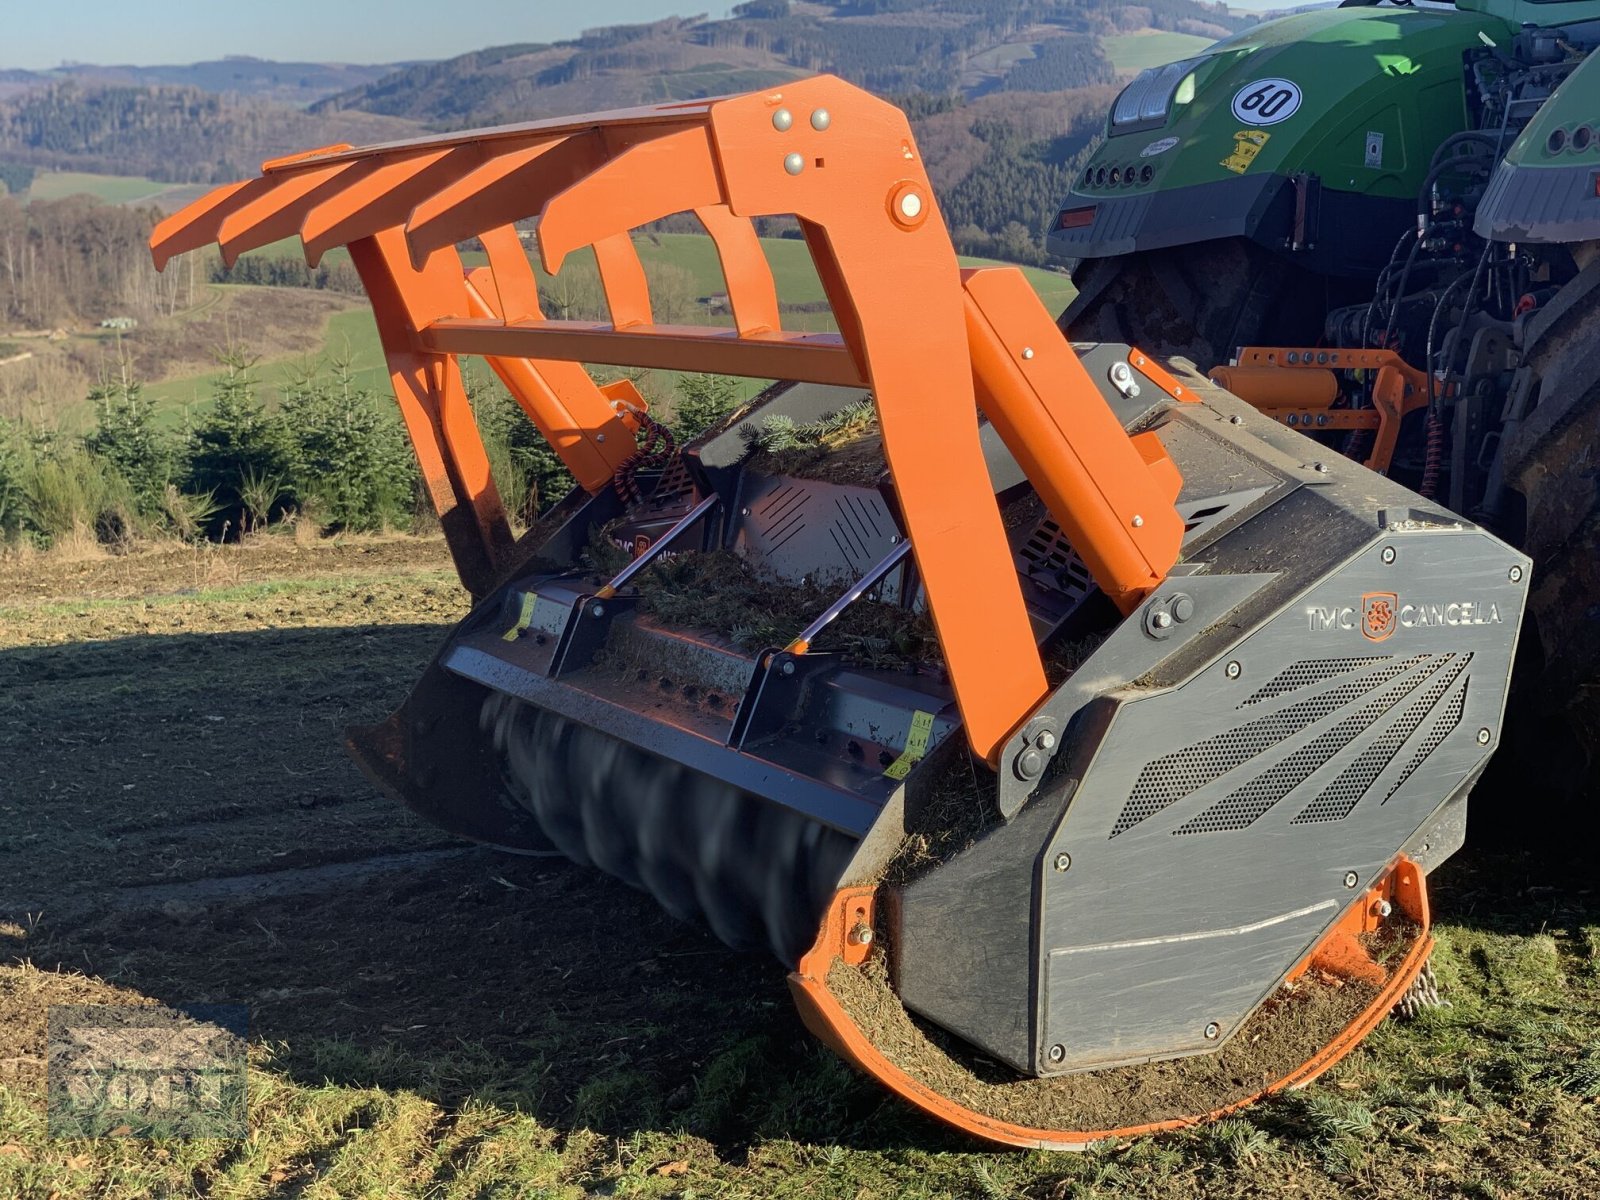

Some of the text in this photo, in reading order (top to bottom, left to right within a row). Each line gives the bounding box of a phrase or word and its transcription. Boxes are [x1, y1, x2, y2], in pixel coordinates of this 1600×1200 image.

[1241, 84, 1293, 118] 60
[1306, 601, 1503, 631] TMC CANCELA
